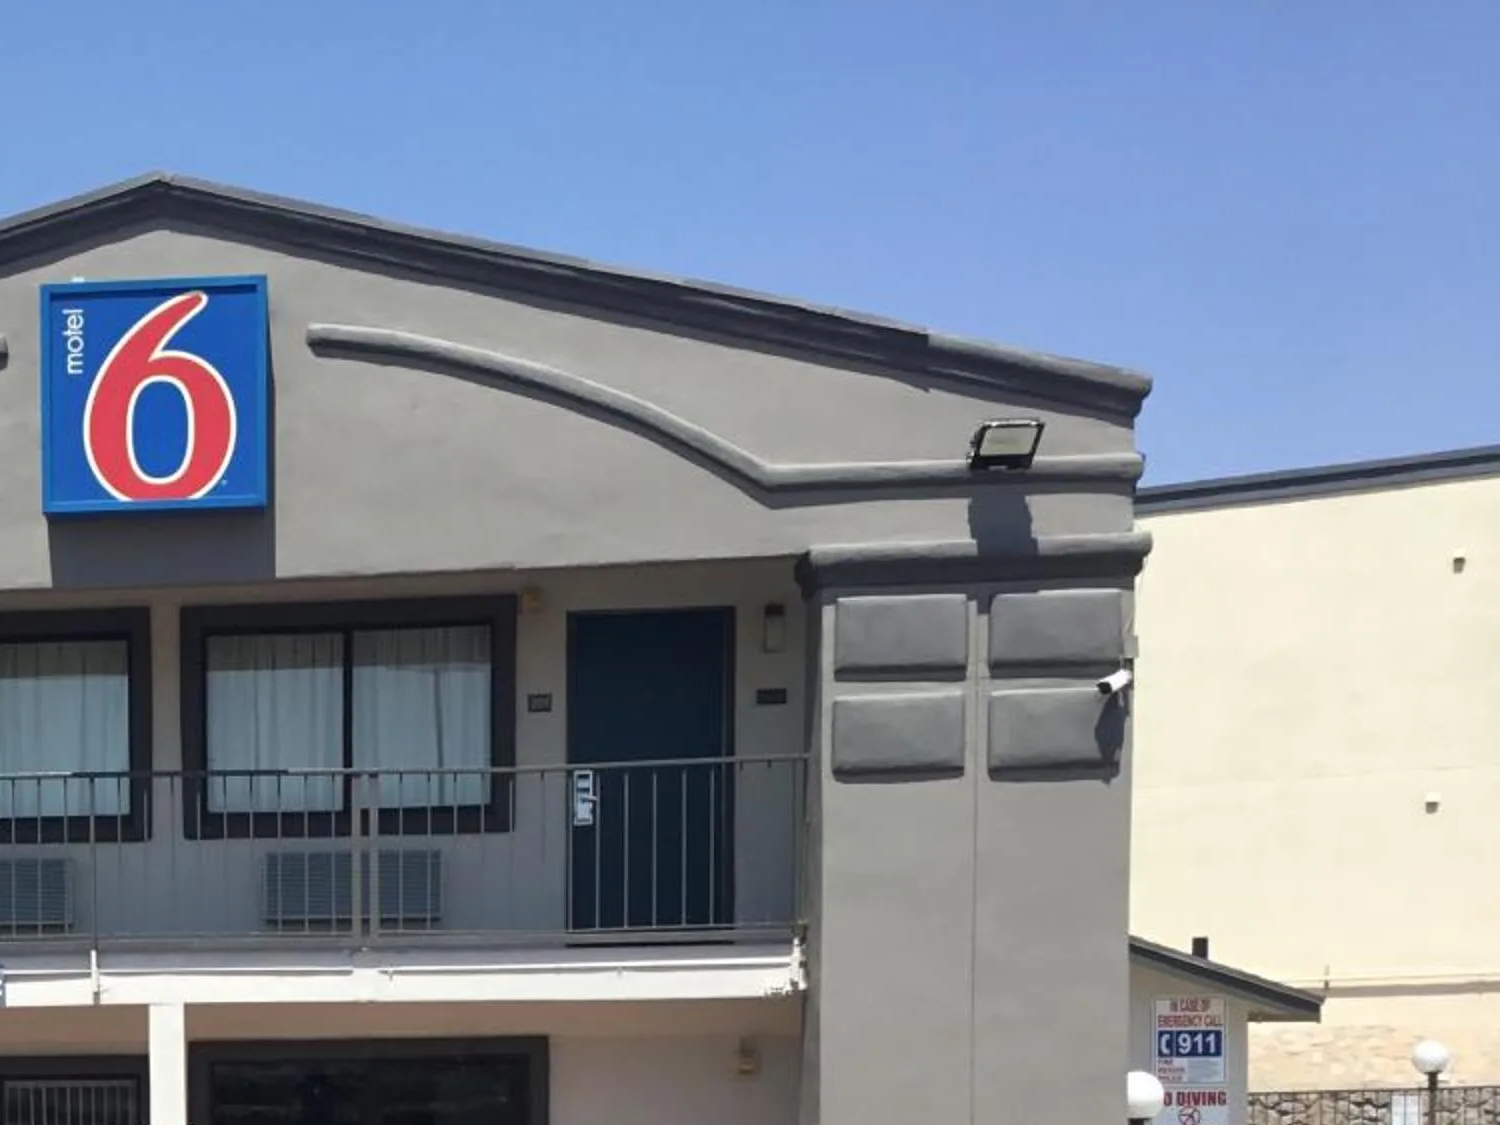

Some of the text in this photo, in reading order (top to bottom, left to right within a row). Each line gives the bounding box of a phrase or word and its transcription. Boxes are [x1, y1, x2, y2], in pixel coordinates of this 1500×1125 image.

[62, 309, 85, 375] motel
[82, 290, 238, 502] 6
[1158, 1014, 1223, 1028] EMERGENCY CALL
[1177, 1033, 1217, 1055] 911
[1176, 1091, 1227, 1107] DIVING
